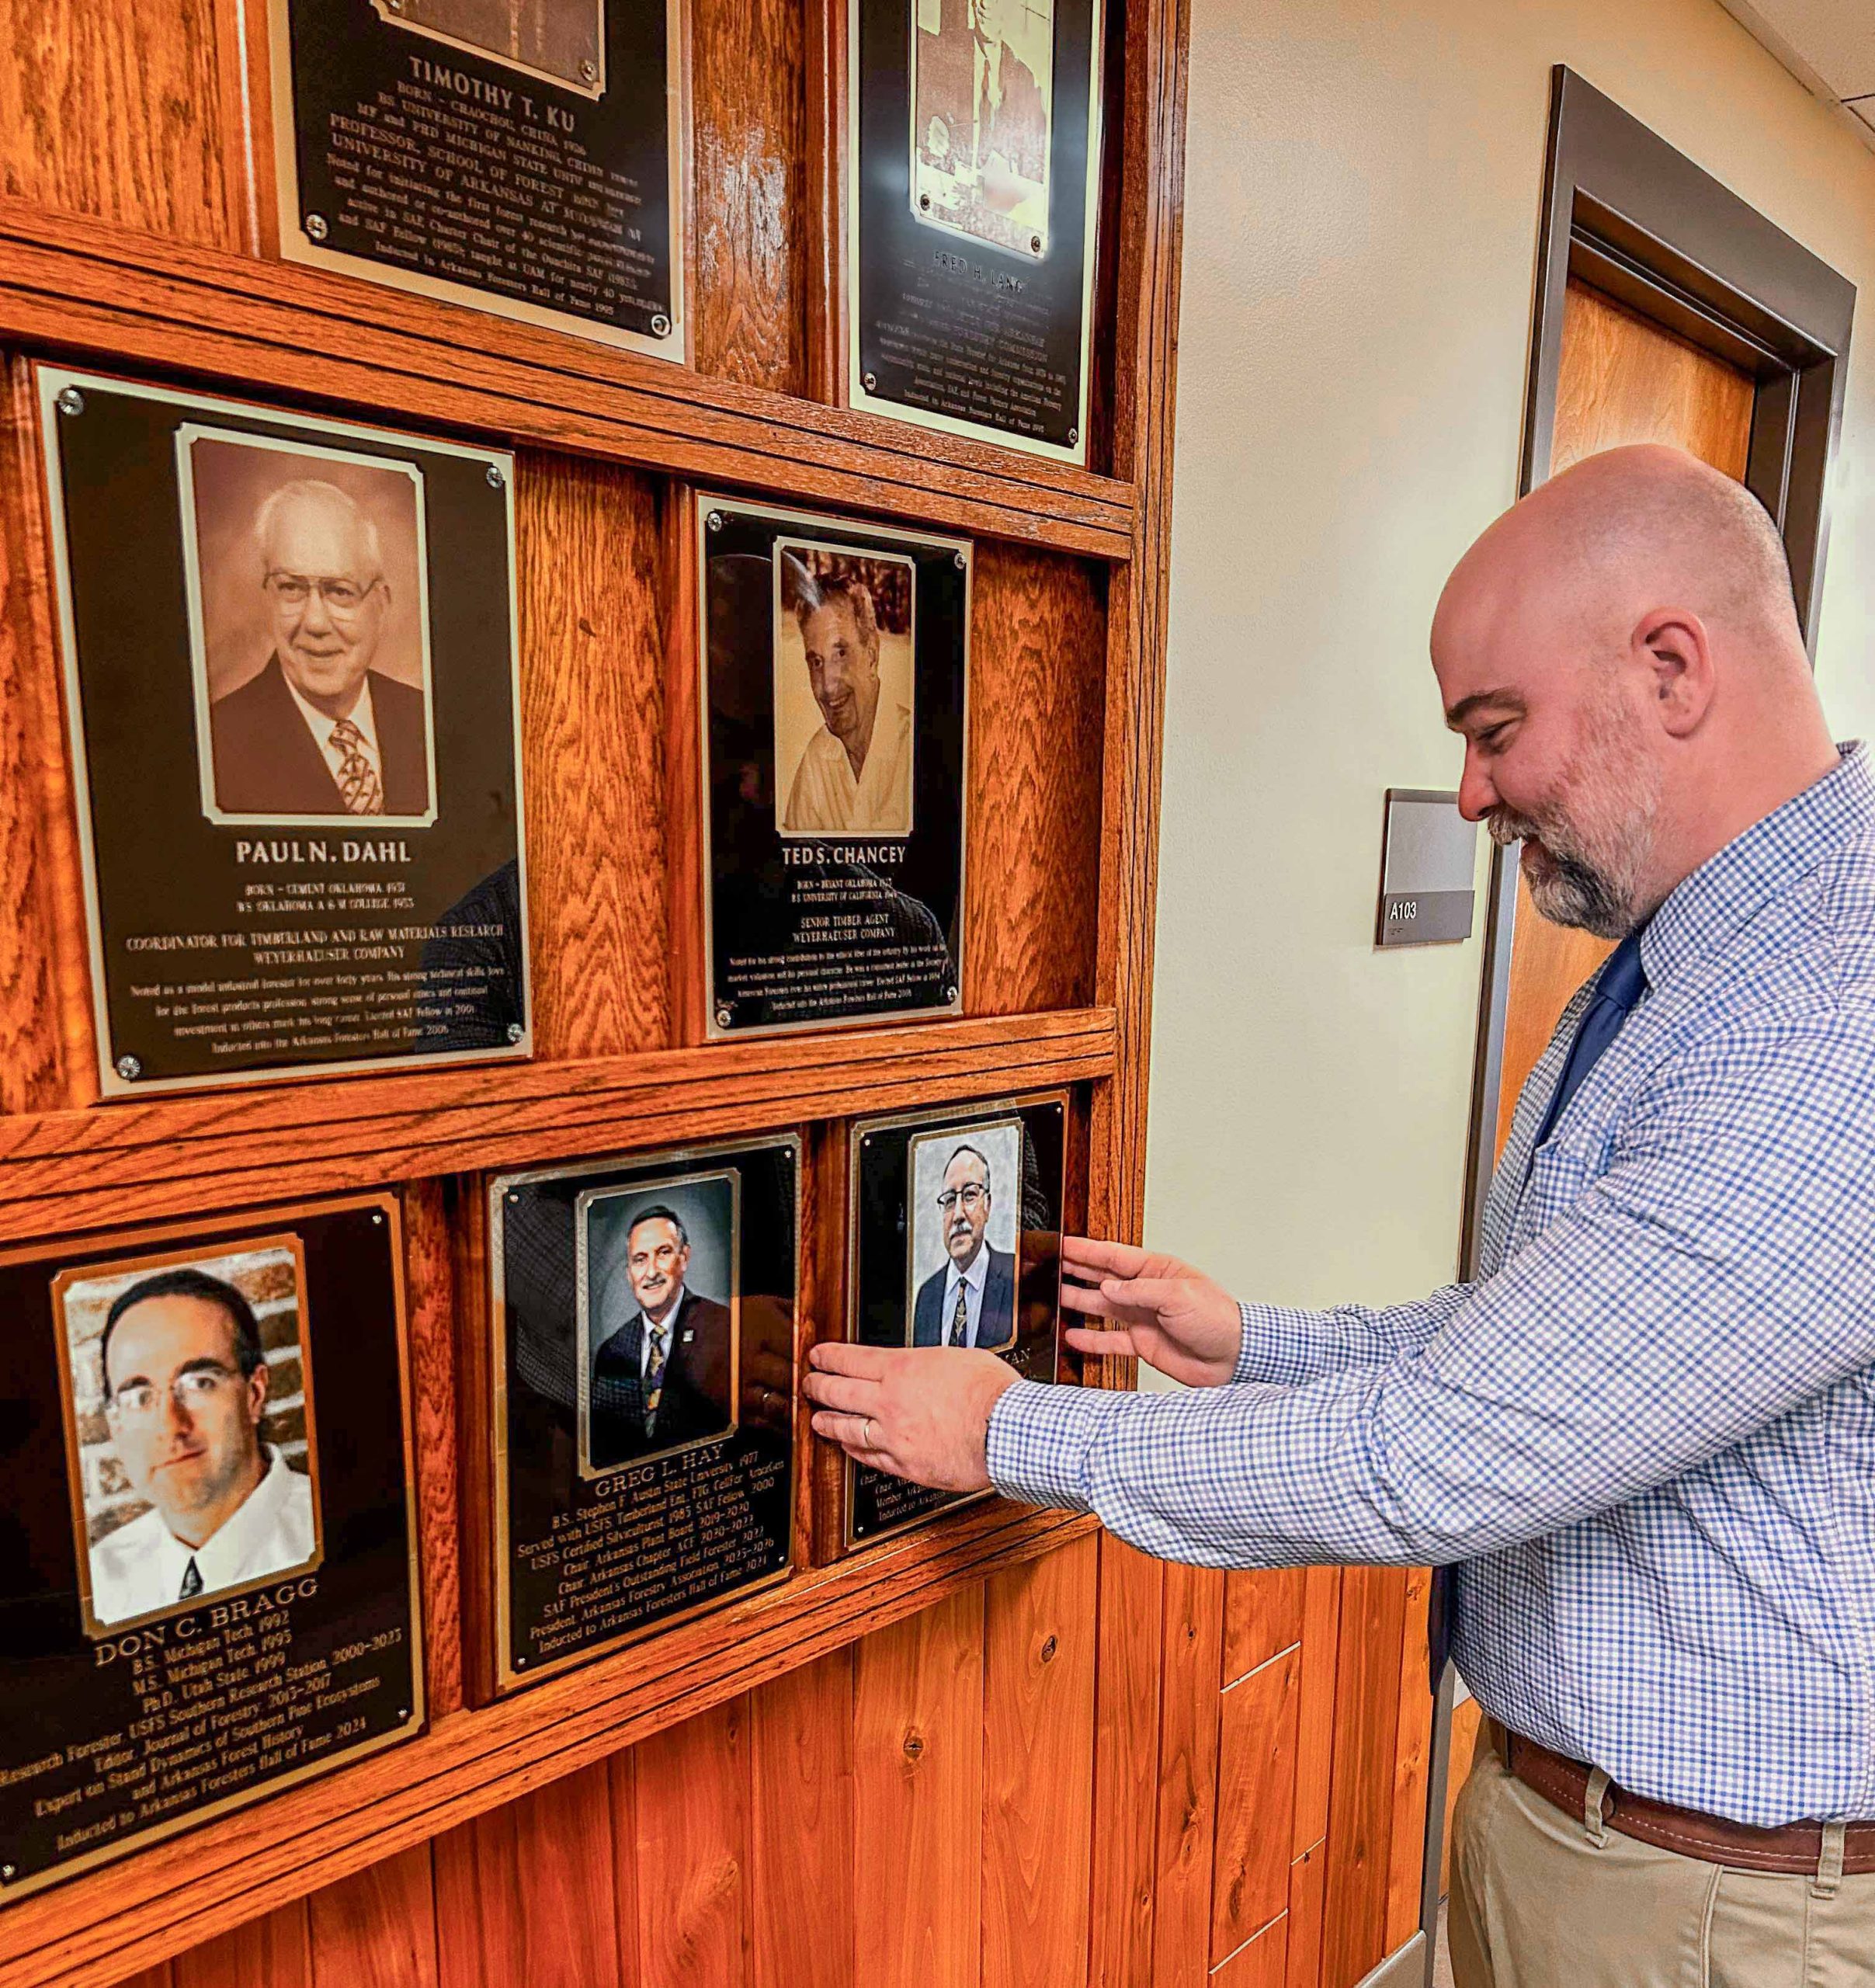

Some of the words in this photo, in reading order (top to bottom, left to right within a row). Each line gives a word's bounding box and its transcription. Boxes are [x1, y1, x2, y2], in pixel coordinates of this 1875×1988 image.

[409, 56, 512, 109] TIMOTHY
[521, 96, 538, 120] T.
[547, 106, 575, 132] KU
[401, 99, 478, 134] UNIVERSITY
[485, 130, 499, 142] OF
[332, 133, 427, 173] UNIVERSITY
[435, 166, 453, 181] OF
[462, 176, 533, 207] ARKANSAS
[429, 144, 484, 174] SCHOOL
[491, 166, 507, 180] OF
[516, 175, 564, 199] FOREST
[513, 155, 547, 175] STATE
[934, 251, 967, 275] FRED
[237, 841, 304, 863] PAUL
[308, 841, 337, 863] N.
[343, 841, 411, 862] DAHL
[782, 847, 813, 865] TED
[817, 847, 830, 865] S.
[834, 846, 905, 864] CHANCEY
[245, 884, 274, 896] BORN
[803, 892, 838, 903] UNIVERSITY
[257, 900, 313, 912] OKLAHOMA
[1390, 901, 1417, 919] A103
[801, 916, 829, 929] SENIOR
[833, 914, 861, 926] TIMBER
[864, 913, 888, 925] AGENT
[126, 934, 218, 951] COORDINATOR
[221, 933, 245, 947] FOR
[251, 930, 328, 946] TIMBERLAND
[332, 929, 356, 943] AND
[360, 928, 383, 942] RAW
[388, 926, 447, 941] MATERIALS
[451, 923, 504, 937] RESEARCH
[860, 926, 894, 940] COMPANY
[354, 946, 405, 961] COMPANY
[595, 1467, 655, 1496] GREG
[662, 1461, 677, 1476] L.
[682, 1444, 724, 1470] HAY
[94, 1625, 166, 1666] DON
[175, 1617, 202, 1638] C.
[210, 1578, 319, 1628] BRAGG
[540, 1629, 582, 1654] Inducted
[600, 1607, 643, 1631] Arkansas
